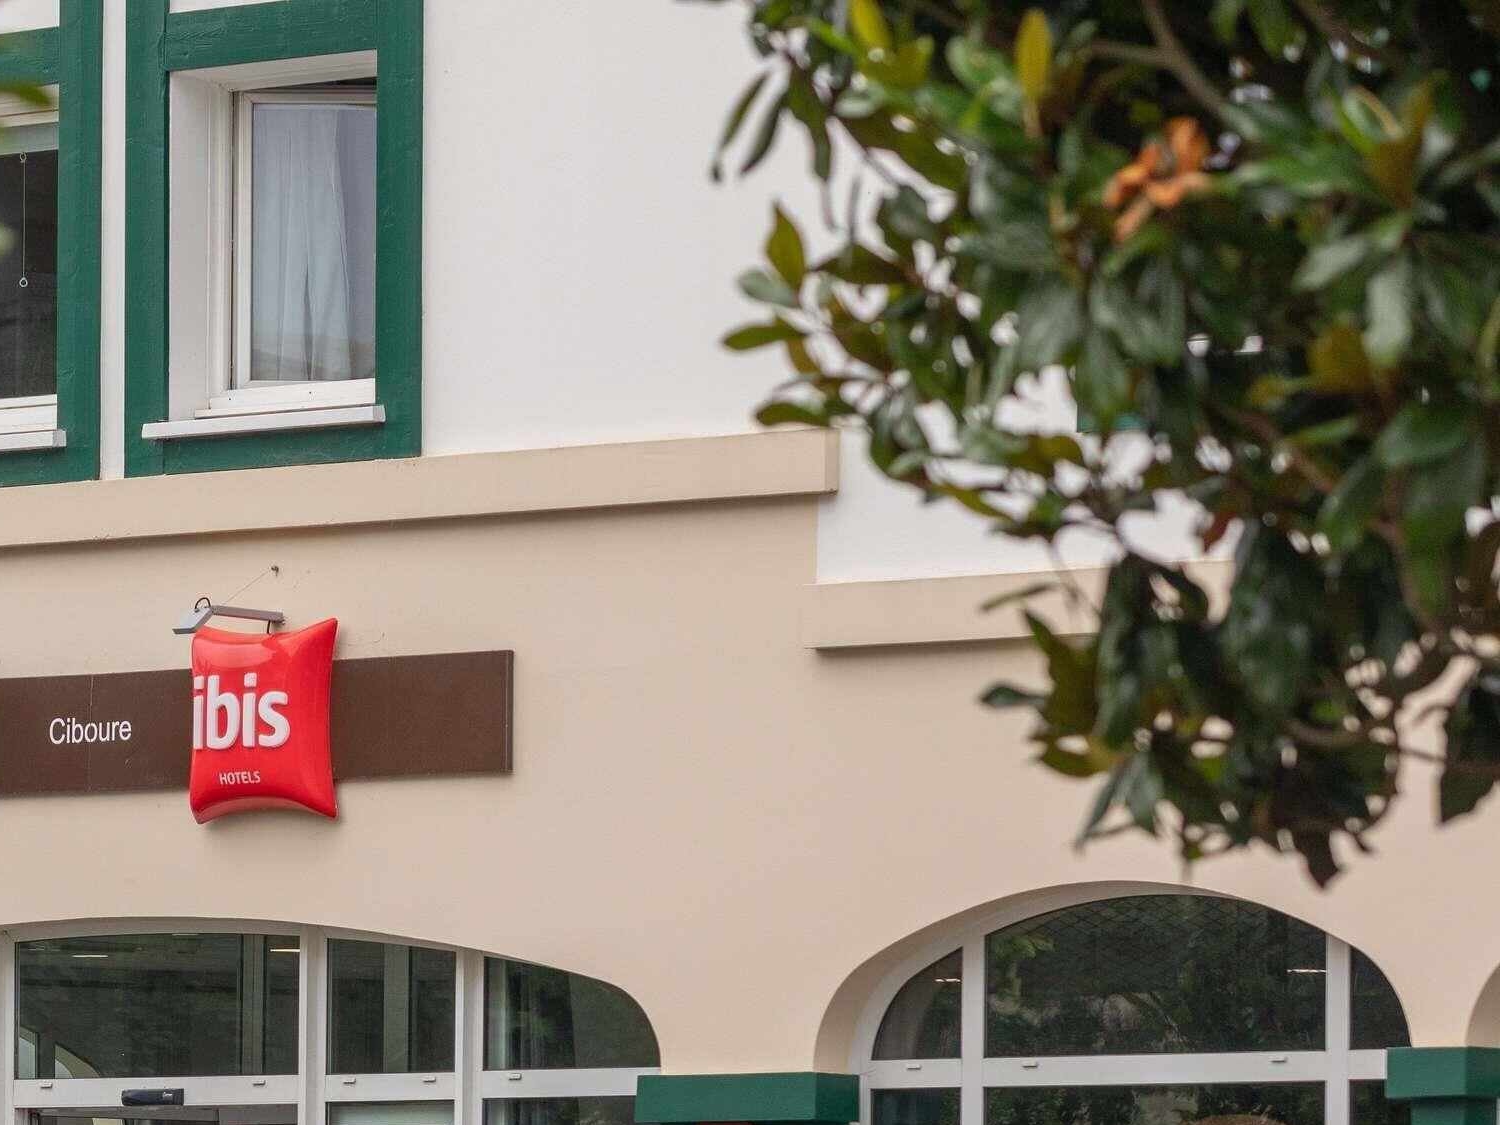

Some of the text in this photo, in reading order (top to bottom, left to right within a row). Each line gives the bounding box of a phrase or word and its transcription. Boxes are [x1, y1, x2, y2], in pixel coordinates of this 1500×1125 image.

[193, 672, 291, 751] ibis
[49, 717, 132, 745] Ciboure
[219, 770, 261, 785] HOTELS
